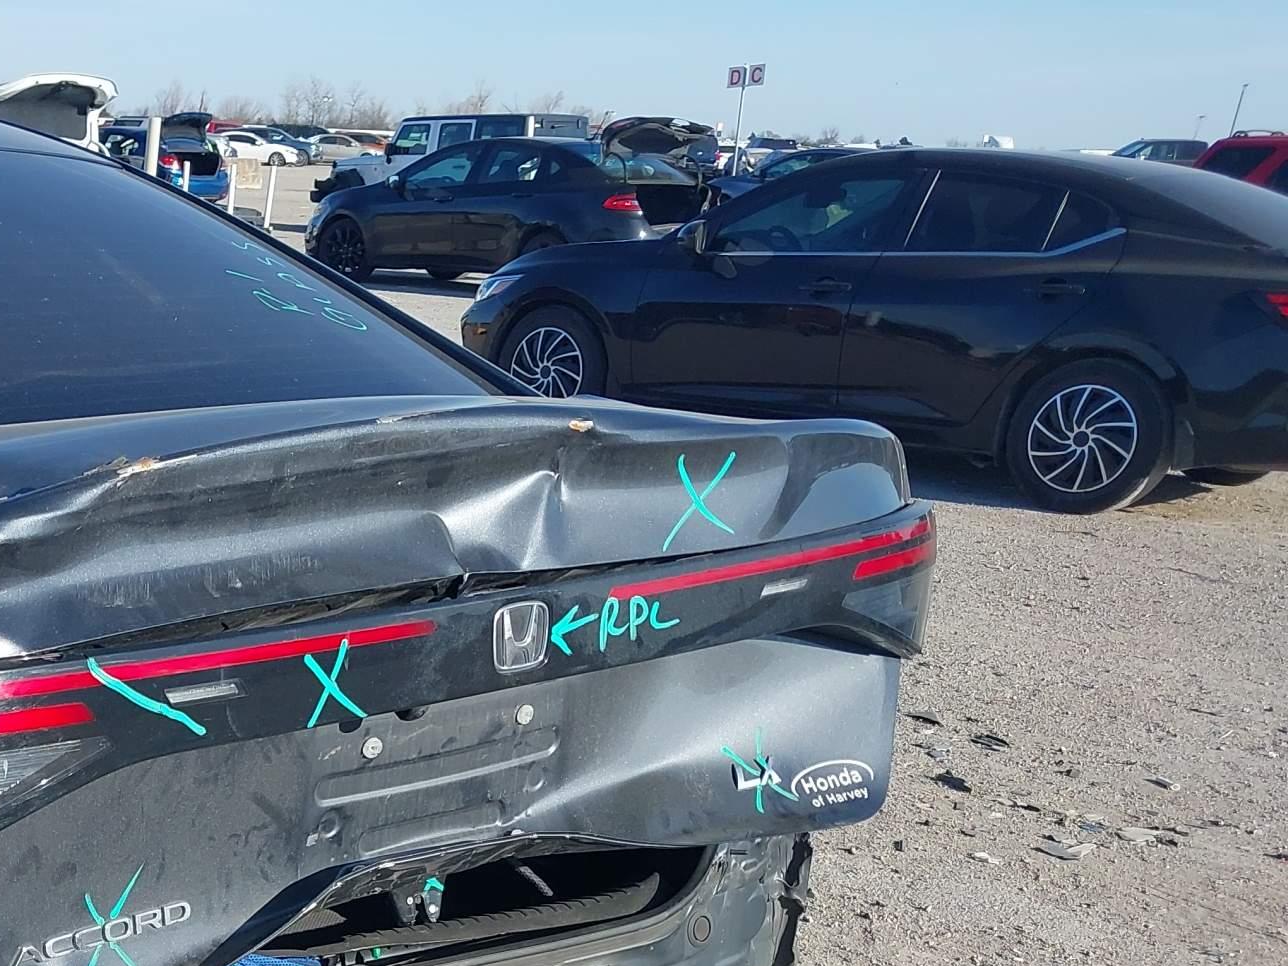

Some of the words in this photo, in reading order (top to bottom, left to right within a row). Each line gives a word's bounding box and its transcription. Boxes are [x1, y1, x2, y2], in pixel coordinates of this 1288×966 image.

[730, 69, 741, 86] D
[752, 67, 763, 84] C
[599, 594, 681, 653] RPL
[800, 767, 864, 795] Honda
[811, 794, 825, 809] of
[827, 786, 869, 805] Harvey
